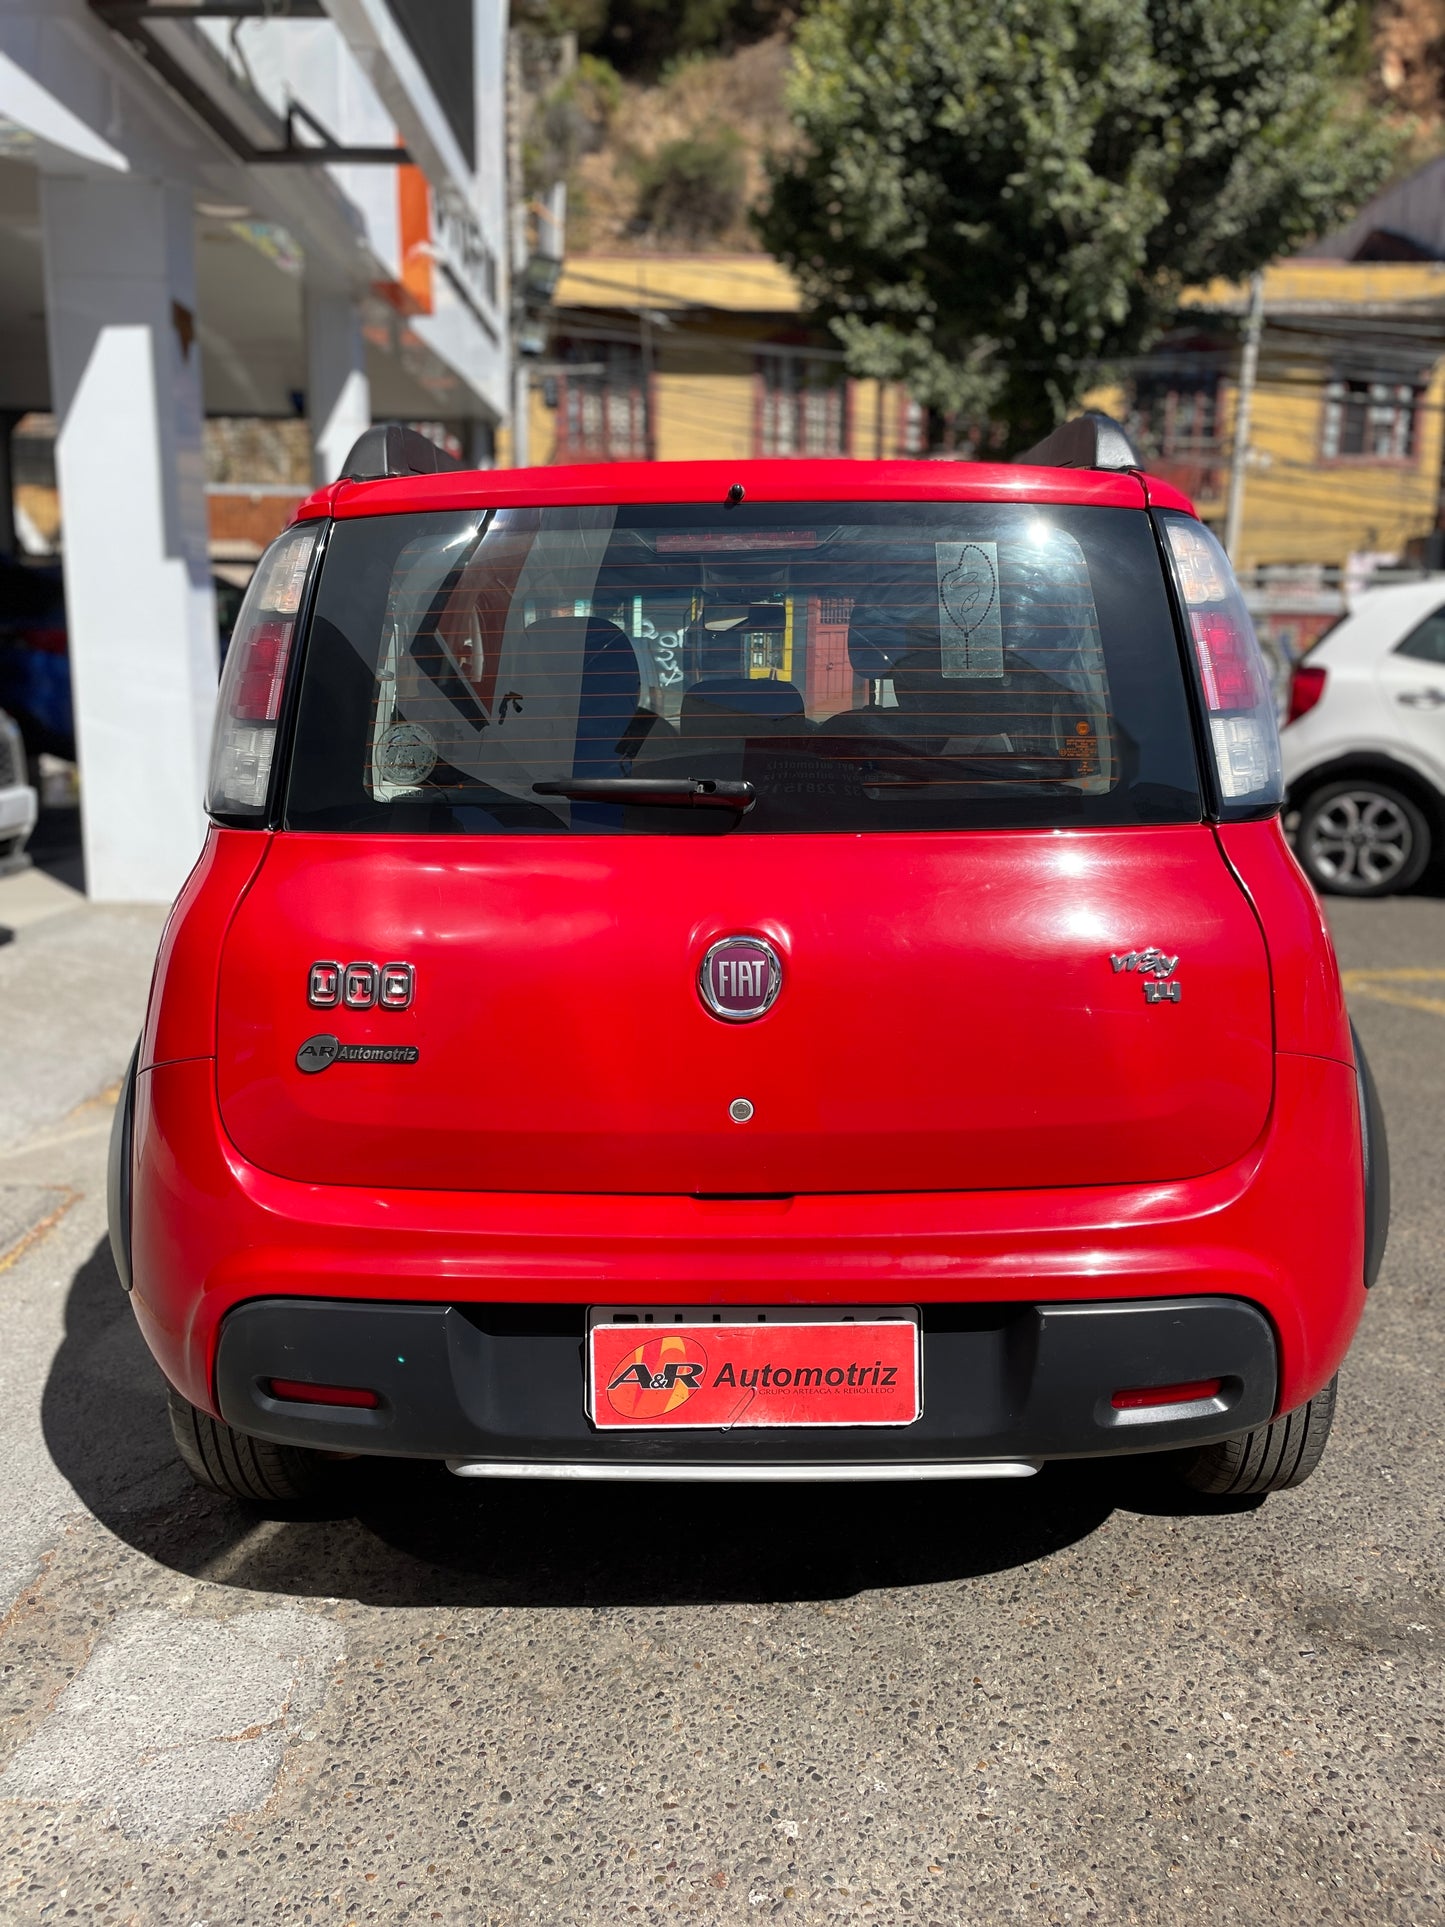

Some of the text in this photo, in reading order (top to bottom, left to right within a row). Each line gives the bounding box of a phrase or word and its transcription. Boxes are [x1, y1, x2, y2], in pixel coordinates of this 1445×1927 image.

[718, 960, 766, 997] FIAT
[338, 1046, 417, 1061] Automotriz
[606, 1361, 898, 1390] A&R Automotriz
